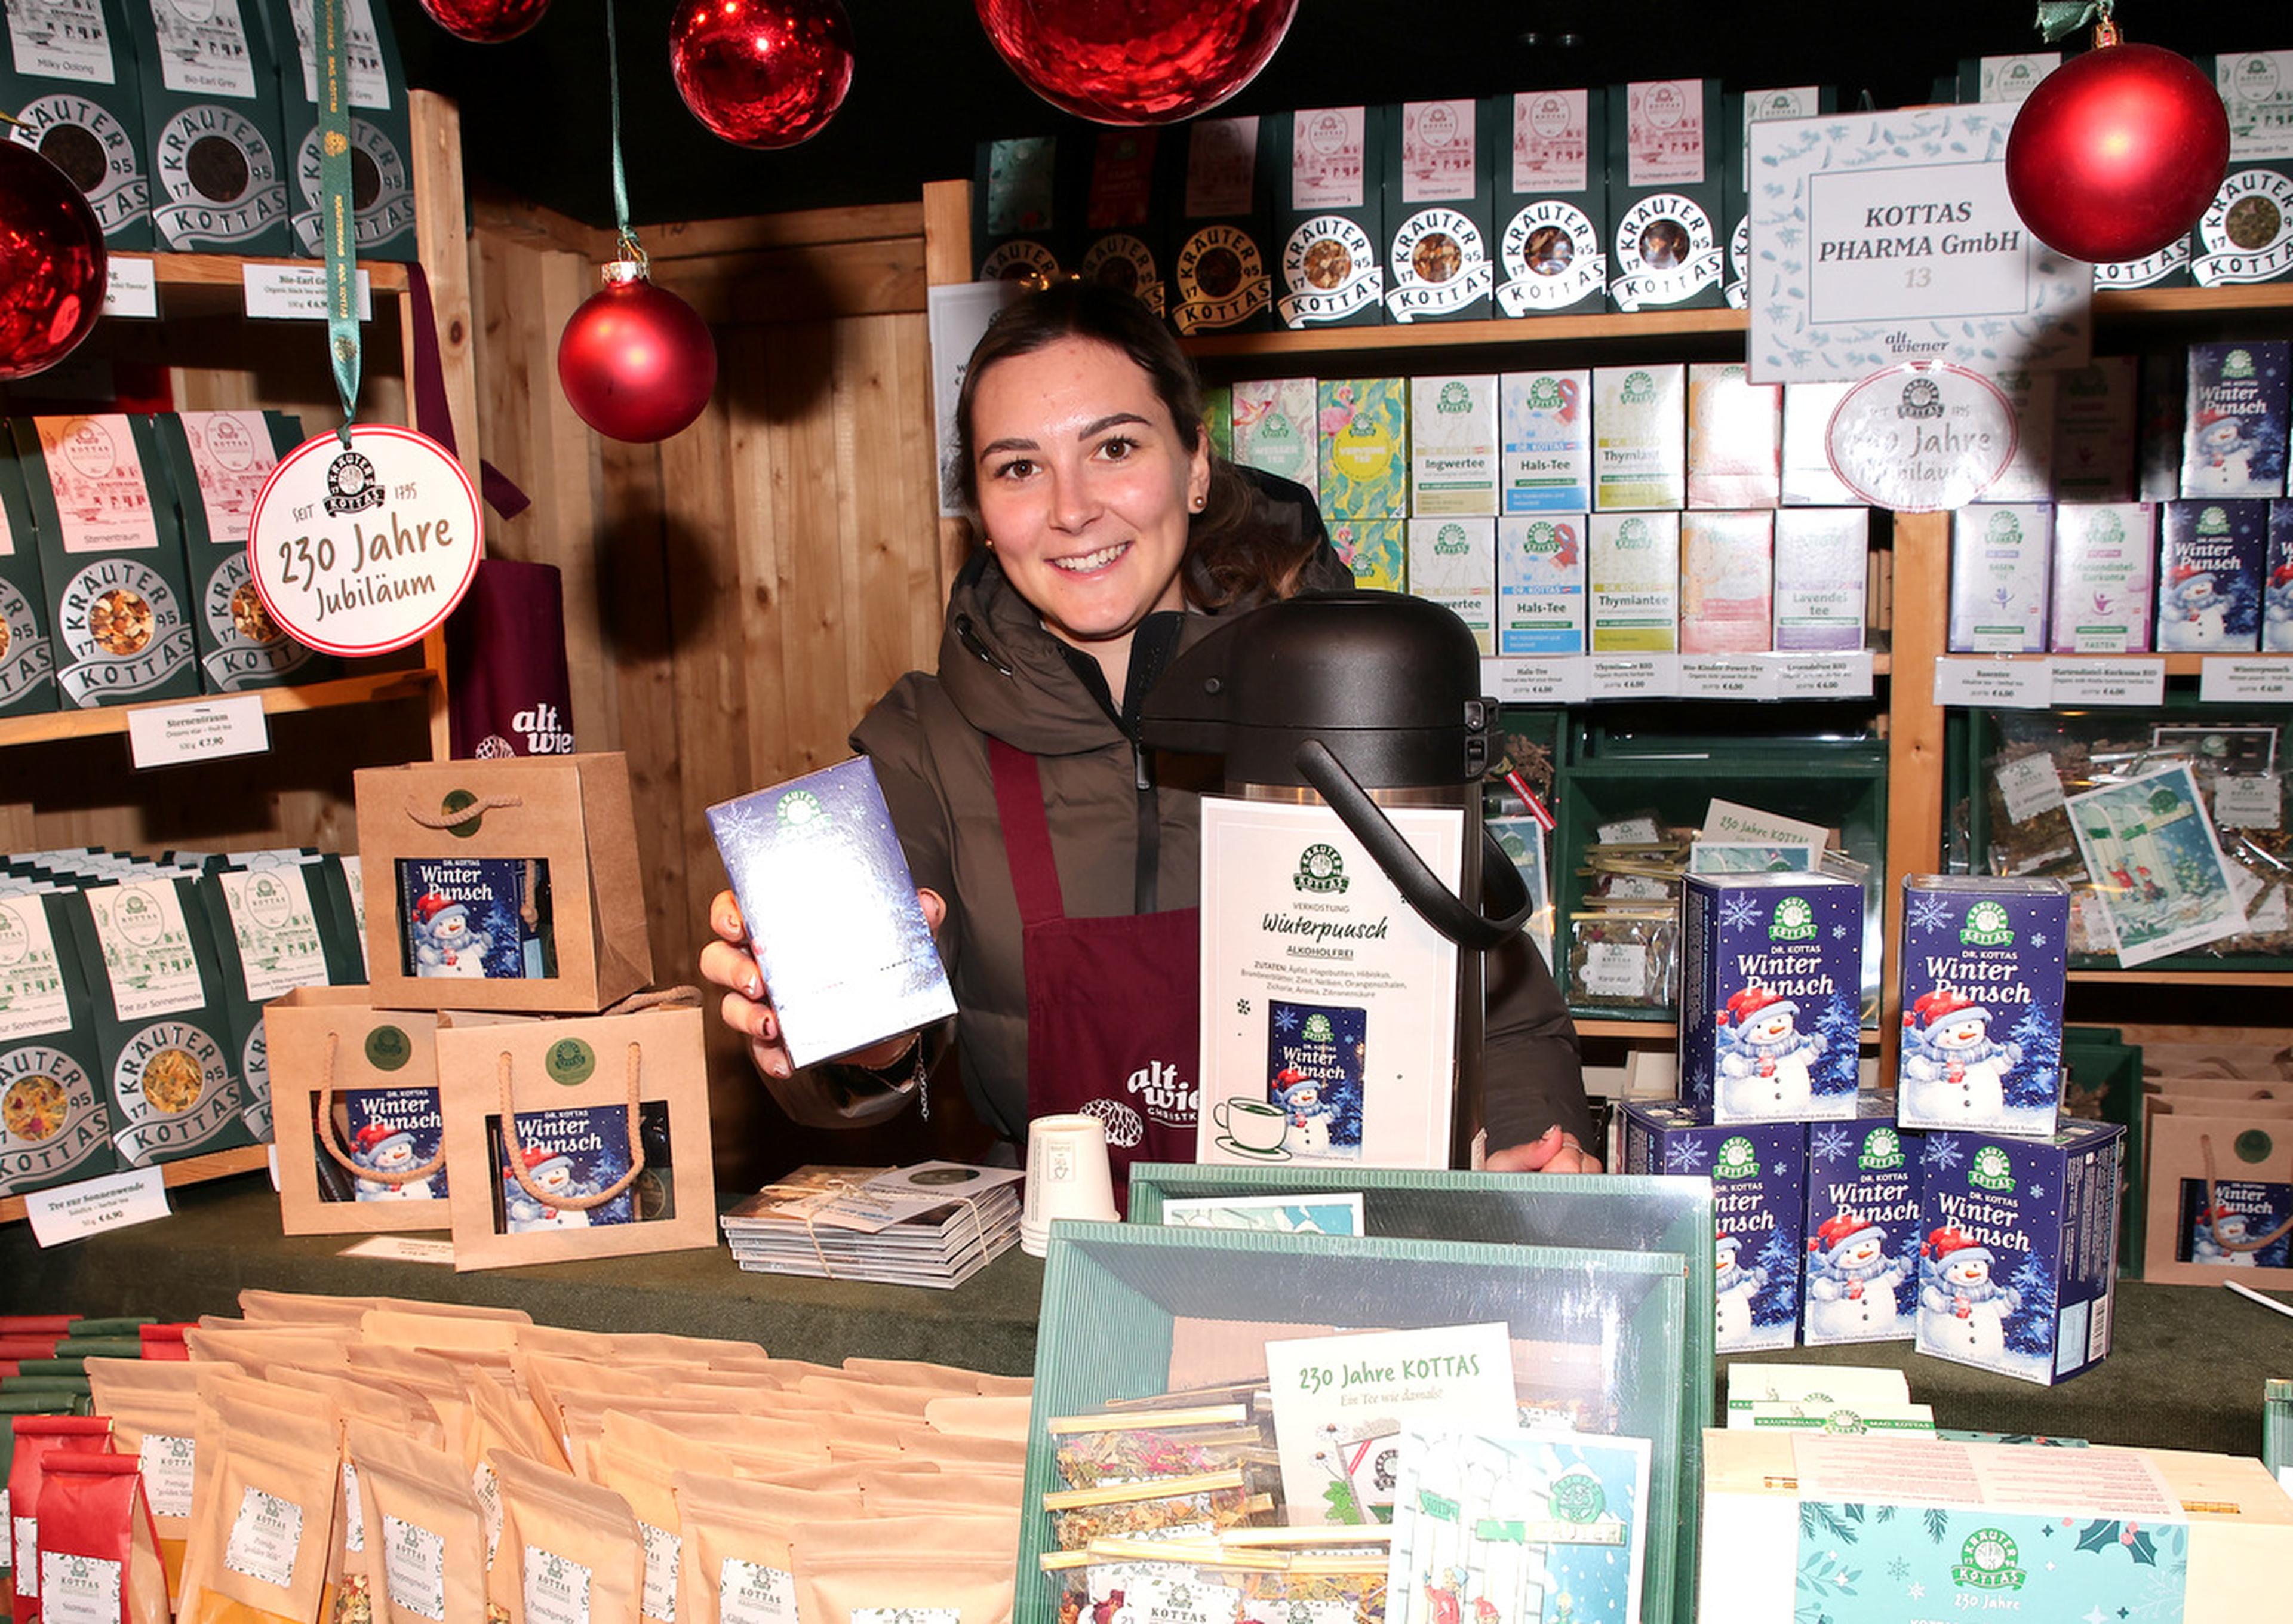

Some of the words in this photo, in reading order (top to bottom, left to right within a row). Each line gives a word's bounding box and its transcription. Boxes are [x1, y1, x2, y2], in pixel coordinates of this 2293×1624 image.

[19, 100, 124, 149] RÄUTER
[164, 105, 264, 171] KRÄUTER
[112, 159, 132, 174] 95
[253, 166, 272, 180] 95
[173, 182, 190, 198] 17
[385, 174, 402, 190] 95
[2207, 174, 2293, 228] KRÄUTER
[176, 192, 287, 231] KOTTAS
[1864, 201, 1973, 228] KOTTAS
[1506, 205, 1589, 256] KRÄUTER
[1621, 199, 1705, 250] KRÄUTER
[1287, 220, 1365, 270] KRÄUTER
[1396, 213, 1477, 262] KRÄUTER
[1692, 238, 1710, 250] 95
[1818, 235, 1933, 262] PHARMA
[1941, 230, 2020, 255] GmbH
[2212, 236, 2226, 250] 17
[1181, 227, 1254, 279] KRÄUTER
[1464, 251, 1481, 263] 95
[1577, 244, 1594, 256] 95
[1354, 258, 1370, 270] 95
[1512, 263, 1525, 277] 17
[1626, 259, 1640, 272] 17
[1292, 276, 1305, 290] 17
[1401, 270, 1415, 283] 17
[1511, 263, 1604, 301] KOTTAS
[1625, 256, 1720, 296] KOTTAS
[1904, 268, 1932, 290] 13
[1292, 275, 1381, 314] KOTTAS
[1400, 270, 1491, 307] KOTTAS
[1186, 281, 1270, 321] KOTTAS
[1892, 338, 1950, 353] wiener
[2200, 385, 2259, 401] Winter
[2204, 399, 2267, 414] Punsch
[1910, 423, 1990, 457] Jahre
[330, 454, 373, 482] KRÄUTER
[1425, 459, 1486, 471] Ingwertee
[1520, 460, 1572, 471] Hals-Tee
[395, 482, 417, 499] 1795
[291, 503, 315, 523] SEIT
[279, 536, 335, 592] 230
[352, 512, 453, 573] Jahre
[2175, 542, 2233, 556] Winter
[2180, 556, 2242, 570] Punsch
[67, 563, 168, 631] KRÄUTER
[316, 573, 436, 622] Jubiläum
[1599, 595, 1668, 607] Thymiantee
[1517, 602, 1566, 614] Hals-Tee
[1809, 605, 1830, 616] tee
[156, 611, 178, 628] 95
[12, 623, 34, 641] 95
[220, 628, 236, 643] 17
[76, 639, 96, 657] 17
[79, 633, 193, 689] KOTTAS
[512, 703, 563, 733] alt.
[1302, 845, 1342, 869] KRÄUTER
[420, 866, 482, 884] Winter
[428, 883, 493, 901] Punsch
[1293, 902, 1350, 913] VERKOSTUNG
[1776, 897, 1812, 920] KRÄUTER
[1969, 903, 2007, 927] KRÄUTER
[1262, 913, 1388, 943] Winterpunsch
[1773, 927, 1814, 939] KOTTAS
[1965, 931, 2011, 943] KOTTAS
[1287, 945, 1354, 958] ALKOHOLFREI
[1787, 945, 1821, 954] KOTTAS
[1980, 951, 2018, 959] KOTTAS
[1737, 955, 1822, 976] Winter
[1926, 956, 2018, 980] Winter
[1745, 973, 1834, 996] Punsch
[1933, 980, 2031, 1004] Punsch
[150, 992, 202, 1008] Sonnenwende
[120, 1025, 215, 1095] KRÄUTER
[1283, 1046, 1338, 1066] Winter
[205, 1066, 224, 1083] 95
[1127, 1060, 1189, 1093] alt.
[1288, 1062, 1346, 1080] Punsch
[70, 1093, 91, 1109] 95
[361, 1097, 429, 1116] Winter
[131, 1103, 148, 1118] 17
[135, 1087, 239, 1149] KOTTAS
[370, 1112, 442, 1130] Punsch
[517, 1119, 590, 1137] Winter
[525, 1135, 603, 1154] Punsch
[1719, 1138, 1754, 1163] KRÄUTER
[1865, 1128, 1900, 1155] KRÄUTER
[1860, 1155, 1904, 1167] KOTTAS
[1975, 1148, 2011, 1179] KRÄUTER
[1716, 1165, 1757, 1176] KOTTAS
[1876, 1173, 1908, 1182] KOTTAS
[1730, 1182, 1763, 1191] KOTTAS
[1972, 1174, 2014, 1189] KOTTAS
[83, 1182, 145, 1202] Sonnenwende
[1828, 1183, 1910, 1204] Winter
[1969, 1192, 1983, 1200] DR.
[1985, 1195, 2018, 1207] KOTTAS
[1835, 1200, 1920, 1223] Punsch
[1939, 1192, 2018, 1227] Winter
[2215, 1198, 2273, 1214] Punsch
[1945, 1215, 2030, 1252] Punsch
[1300, 1367, 1333, 1394] 230
[1342, 1361, 1395, 1389] Jahre
[1403, 1354, 1479, 1380] KOTTAS
[256, 1514, 287, 1530] KOTTAS
[1965, 1530, 2017, 1557] KRÄUTER
[396, 1544, 426, 1562] KOTTAS
[61, 1577, 100, 1589] KOTTAS
[538, 1574, 570, 1593] KOTTAS
[1959, 1567, 2020, 1585] KOTTAS
[740, 1587, 782, 1604] KOTTAS
[1954, 1594, 1978, 1610] 230
[1982, 1595, 2020, 1610] Jahre
[1151, 1607, 1207, 1623] KOTTAS
